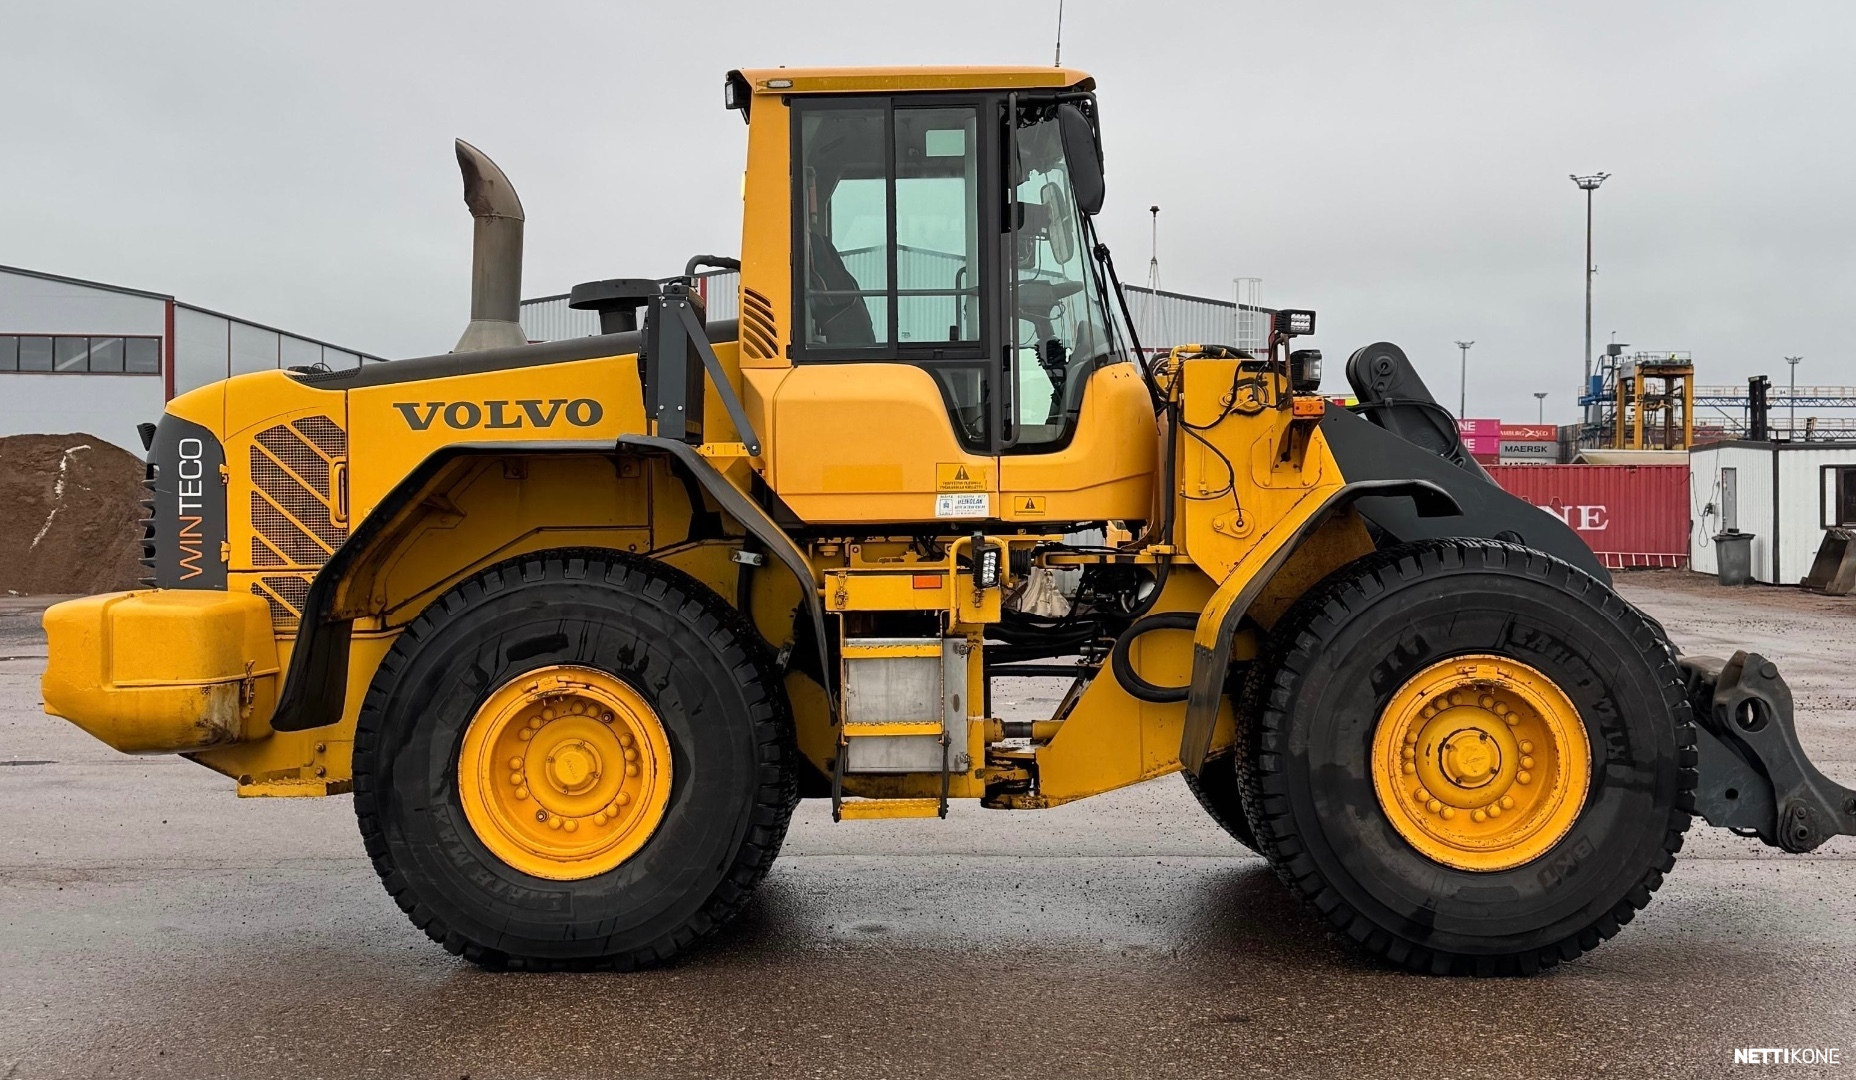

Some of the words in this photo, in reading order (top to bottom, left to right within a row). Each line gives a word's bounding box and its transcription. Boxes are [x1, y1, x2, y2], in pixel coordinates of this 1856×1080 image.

[393, 399, 604, 430] VOLVO
[1457, 421, 1476, 431] NE
[1504, 445, 1548, 453] MAERSK
[178, 438, 203, 581] WINTECO
[1537, 505, 1609, 531] NE
